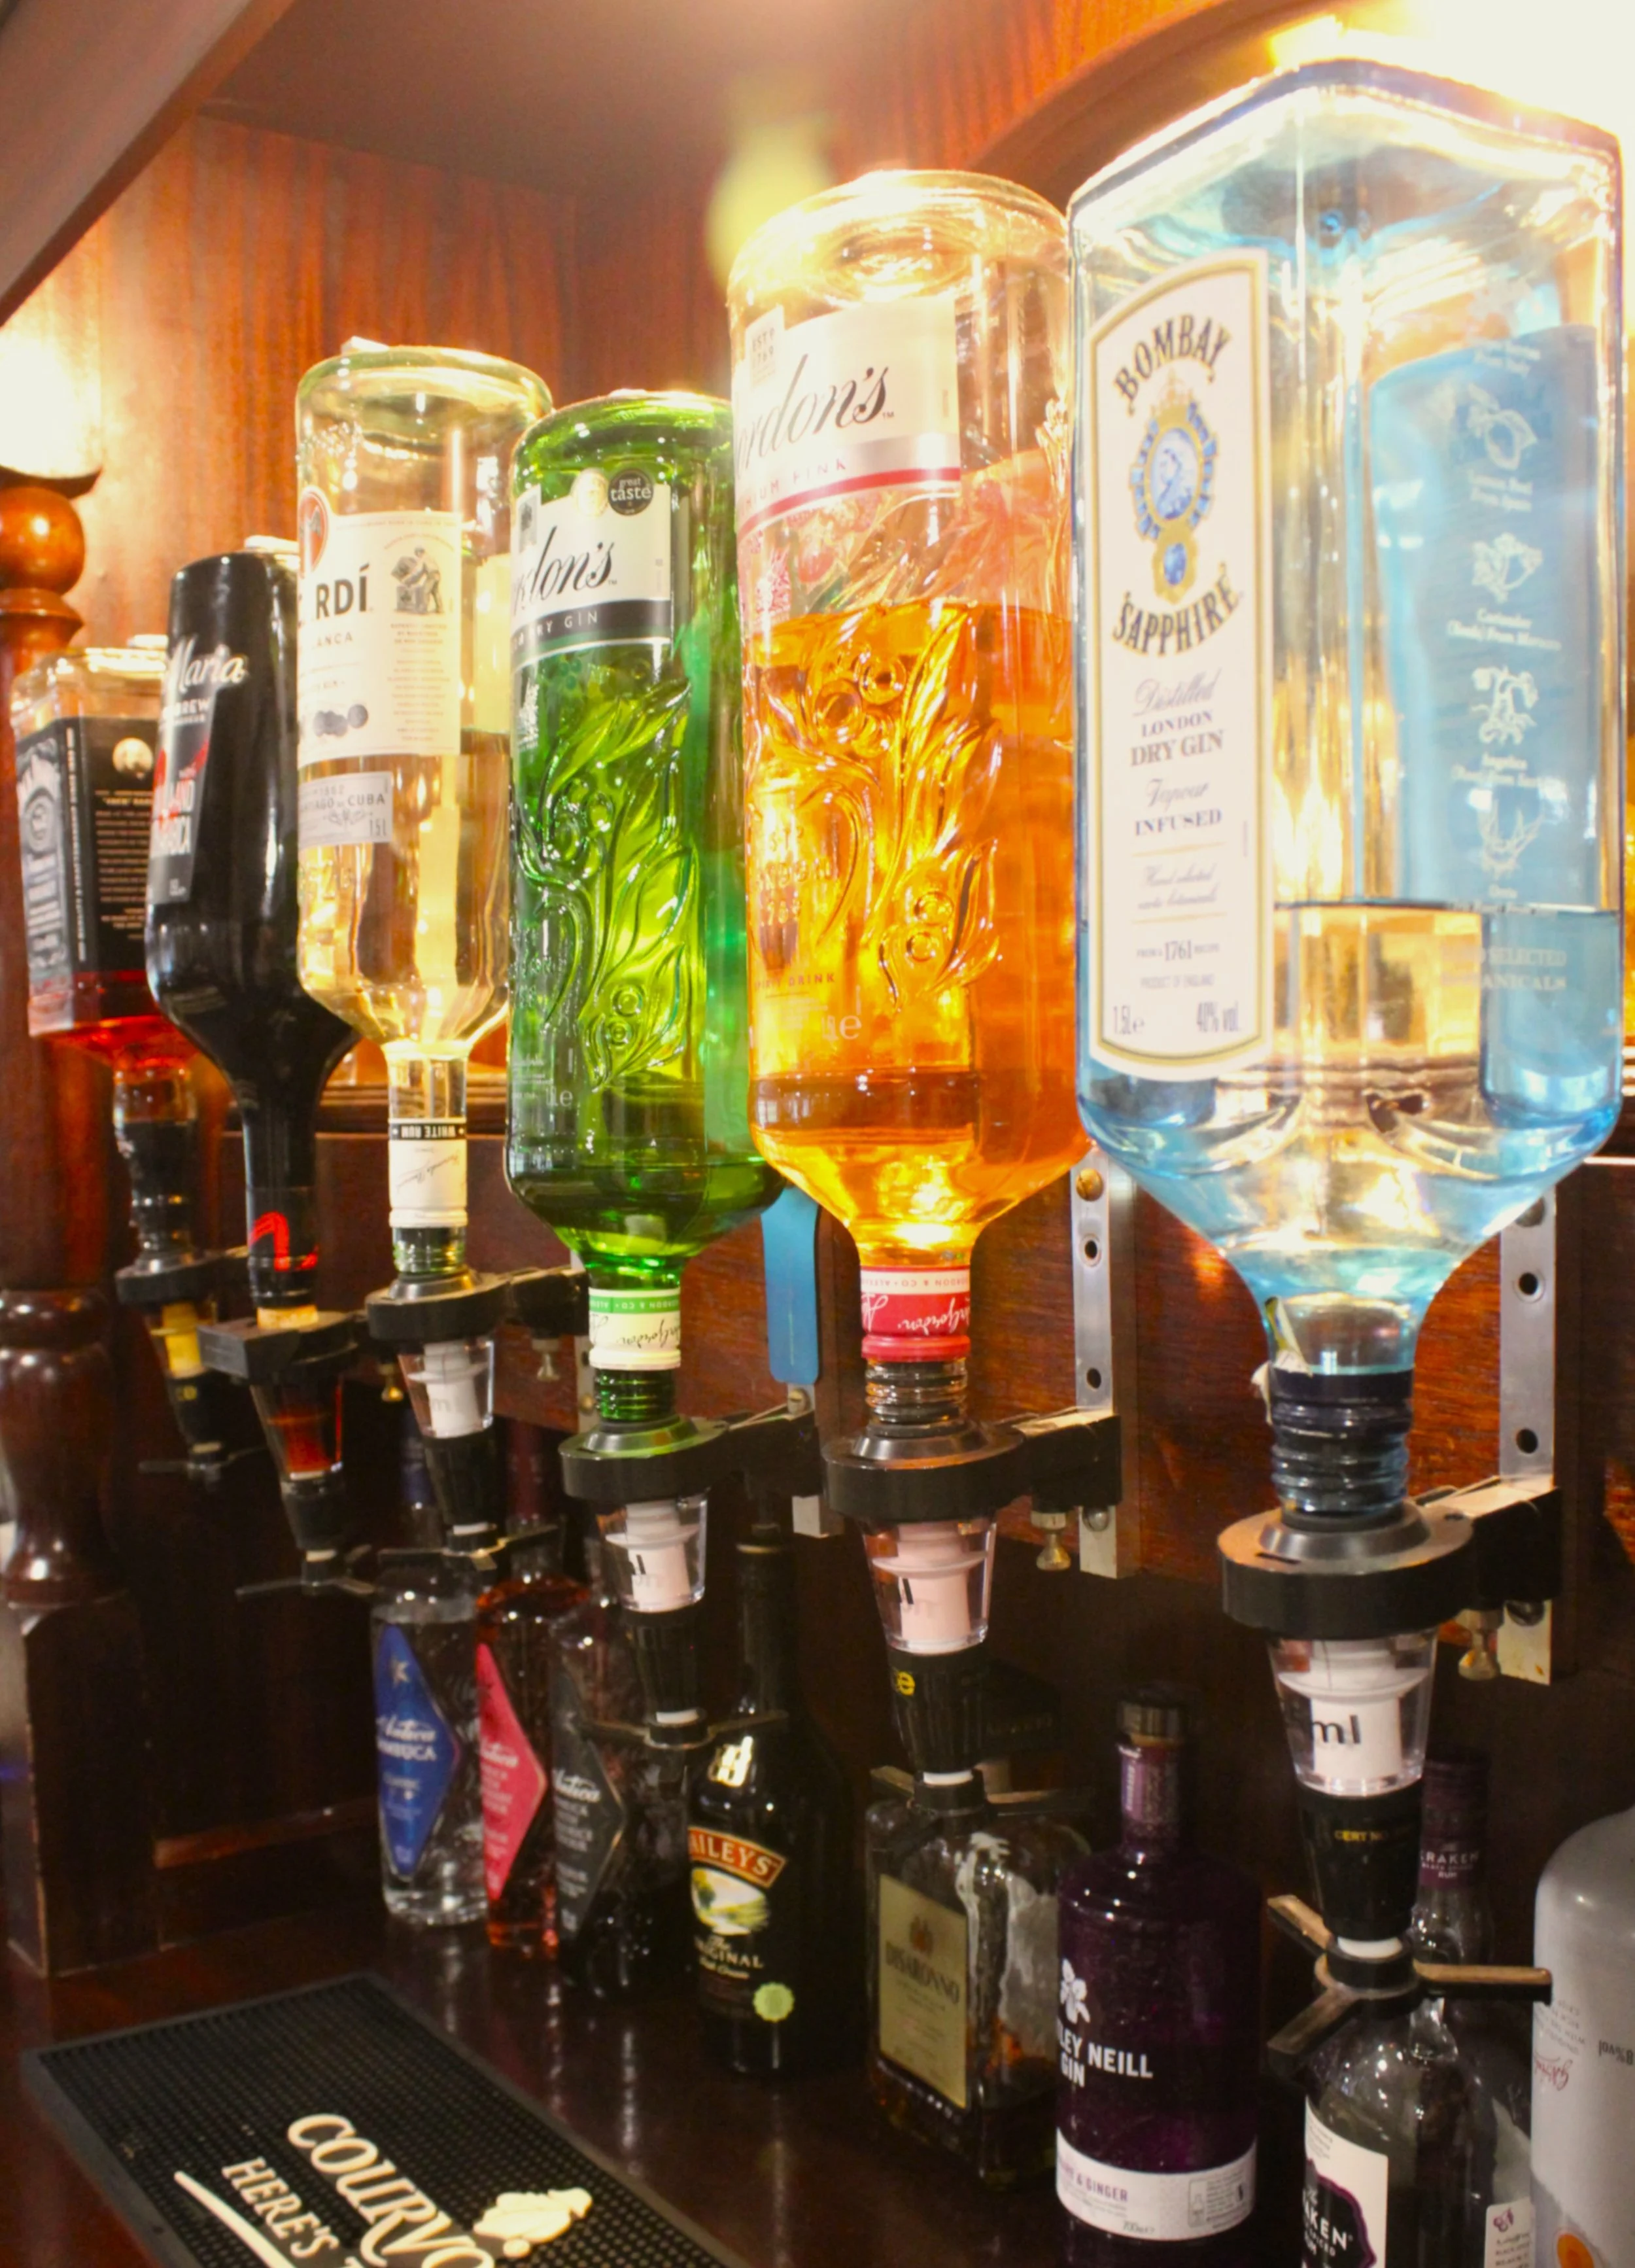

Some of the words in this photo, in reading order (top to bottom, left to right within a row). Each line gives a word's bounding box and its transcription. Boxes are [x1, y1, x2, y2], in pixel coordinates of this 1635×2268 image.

[1114, 314, 1231, 417] BOMBAY
[737, 353, 889, 480] ordon's
[611, 485, 652, 503] taste
[619, 476, 642, 493] great
[564, 611, 598, 632] GIN
[1113, 561, 1240, 657] SAPPHIRE
[1133, 667, 1222, 717] Distilled
[1141, 711, 1213, 737] LONDON
[1130, 741, 1175, 767] DRY
[1180, 730, 1224, 758] GIN
[347, 793, 386, 807] CUBA
[1135, 809, 1222, 837] INFUSED
[1164, 939, 1192, 962] 1761
[1060, 2050, 1086, 2088] GIN
[1087, 2042, 1154, 2079] NEILL
[1086, 2178, 1129, 2203] GINGER
[221, 2157, 340, 2259] HERE'S
